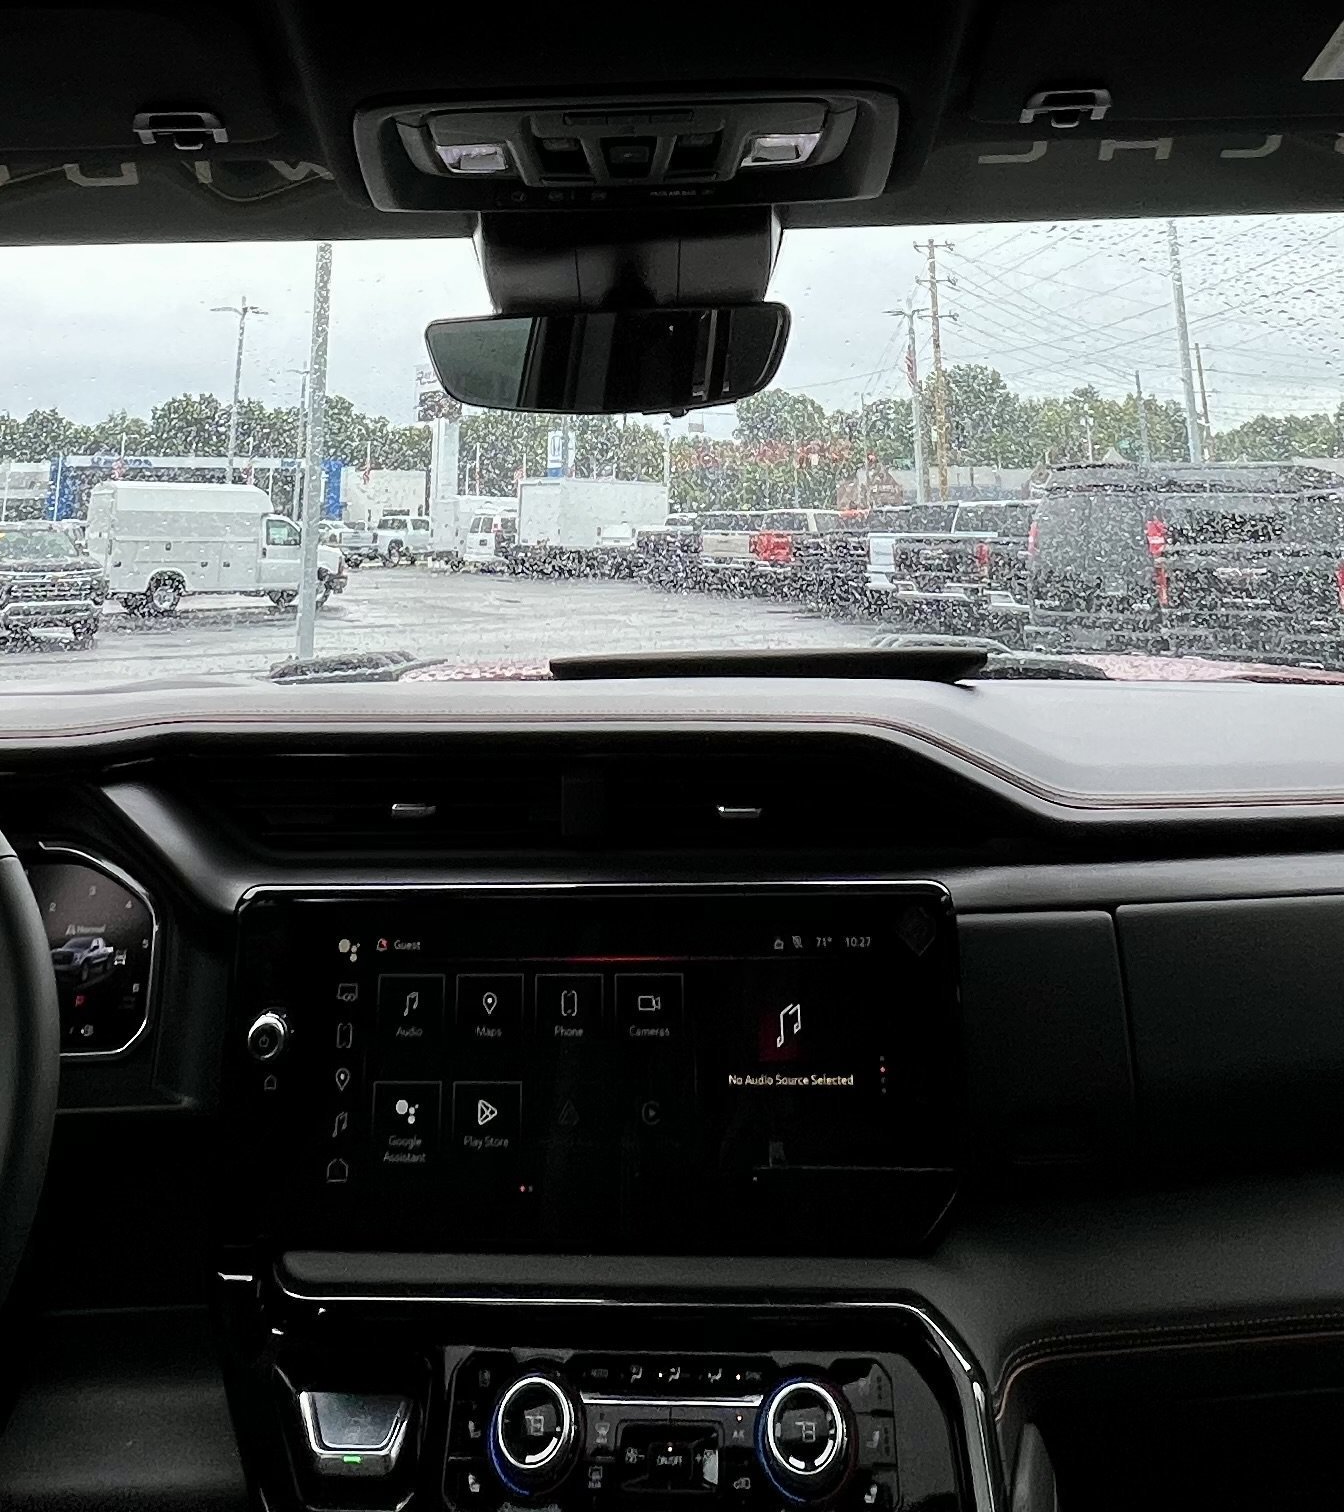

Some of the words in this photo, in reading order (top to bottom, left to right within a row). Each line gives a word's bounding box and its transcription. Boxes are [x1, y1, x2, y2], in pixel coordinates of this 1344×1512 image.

[394, 939, 421, 950] Guest
[396, 1026, 423, 1037] Audio
[476, 1025, 504, 1039] Maps
[554, 1025, 584, 1037] Phone
[629, 1025, 670, 1037] Cameras
[728, 1074, 743, 1086] No
[744, 1073, 774, 1086] Audio
[775, 1074, 809, 1086] Source
[811, 1073, 854, 1086] Selected
[388, 1135, 423, 1150] Google
[463, 1135, 484, 1150] Play
[485, 1135, 510, 1148] Store
[383, 1151, 426, 1163] Assistant
